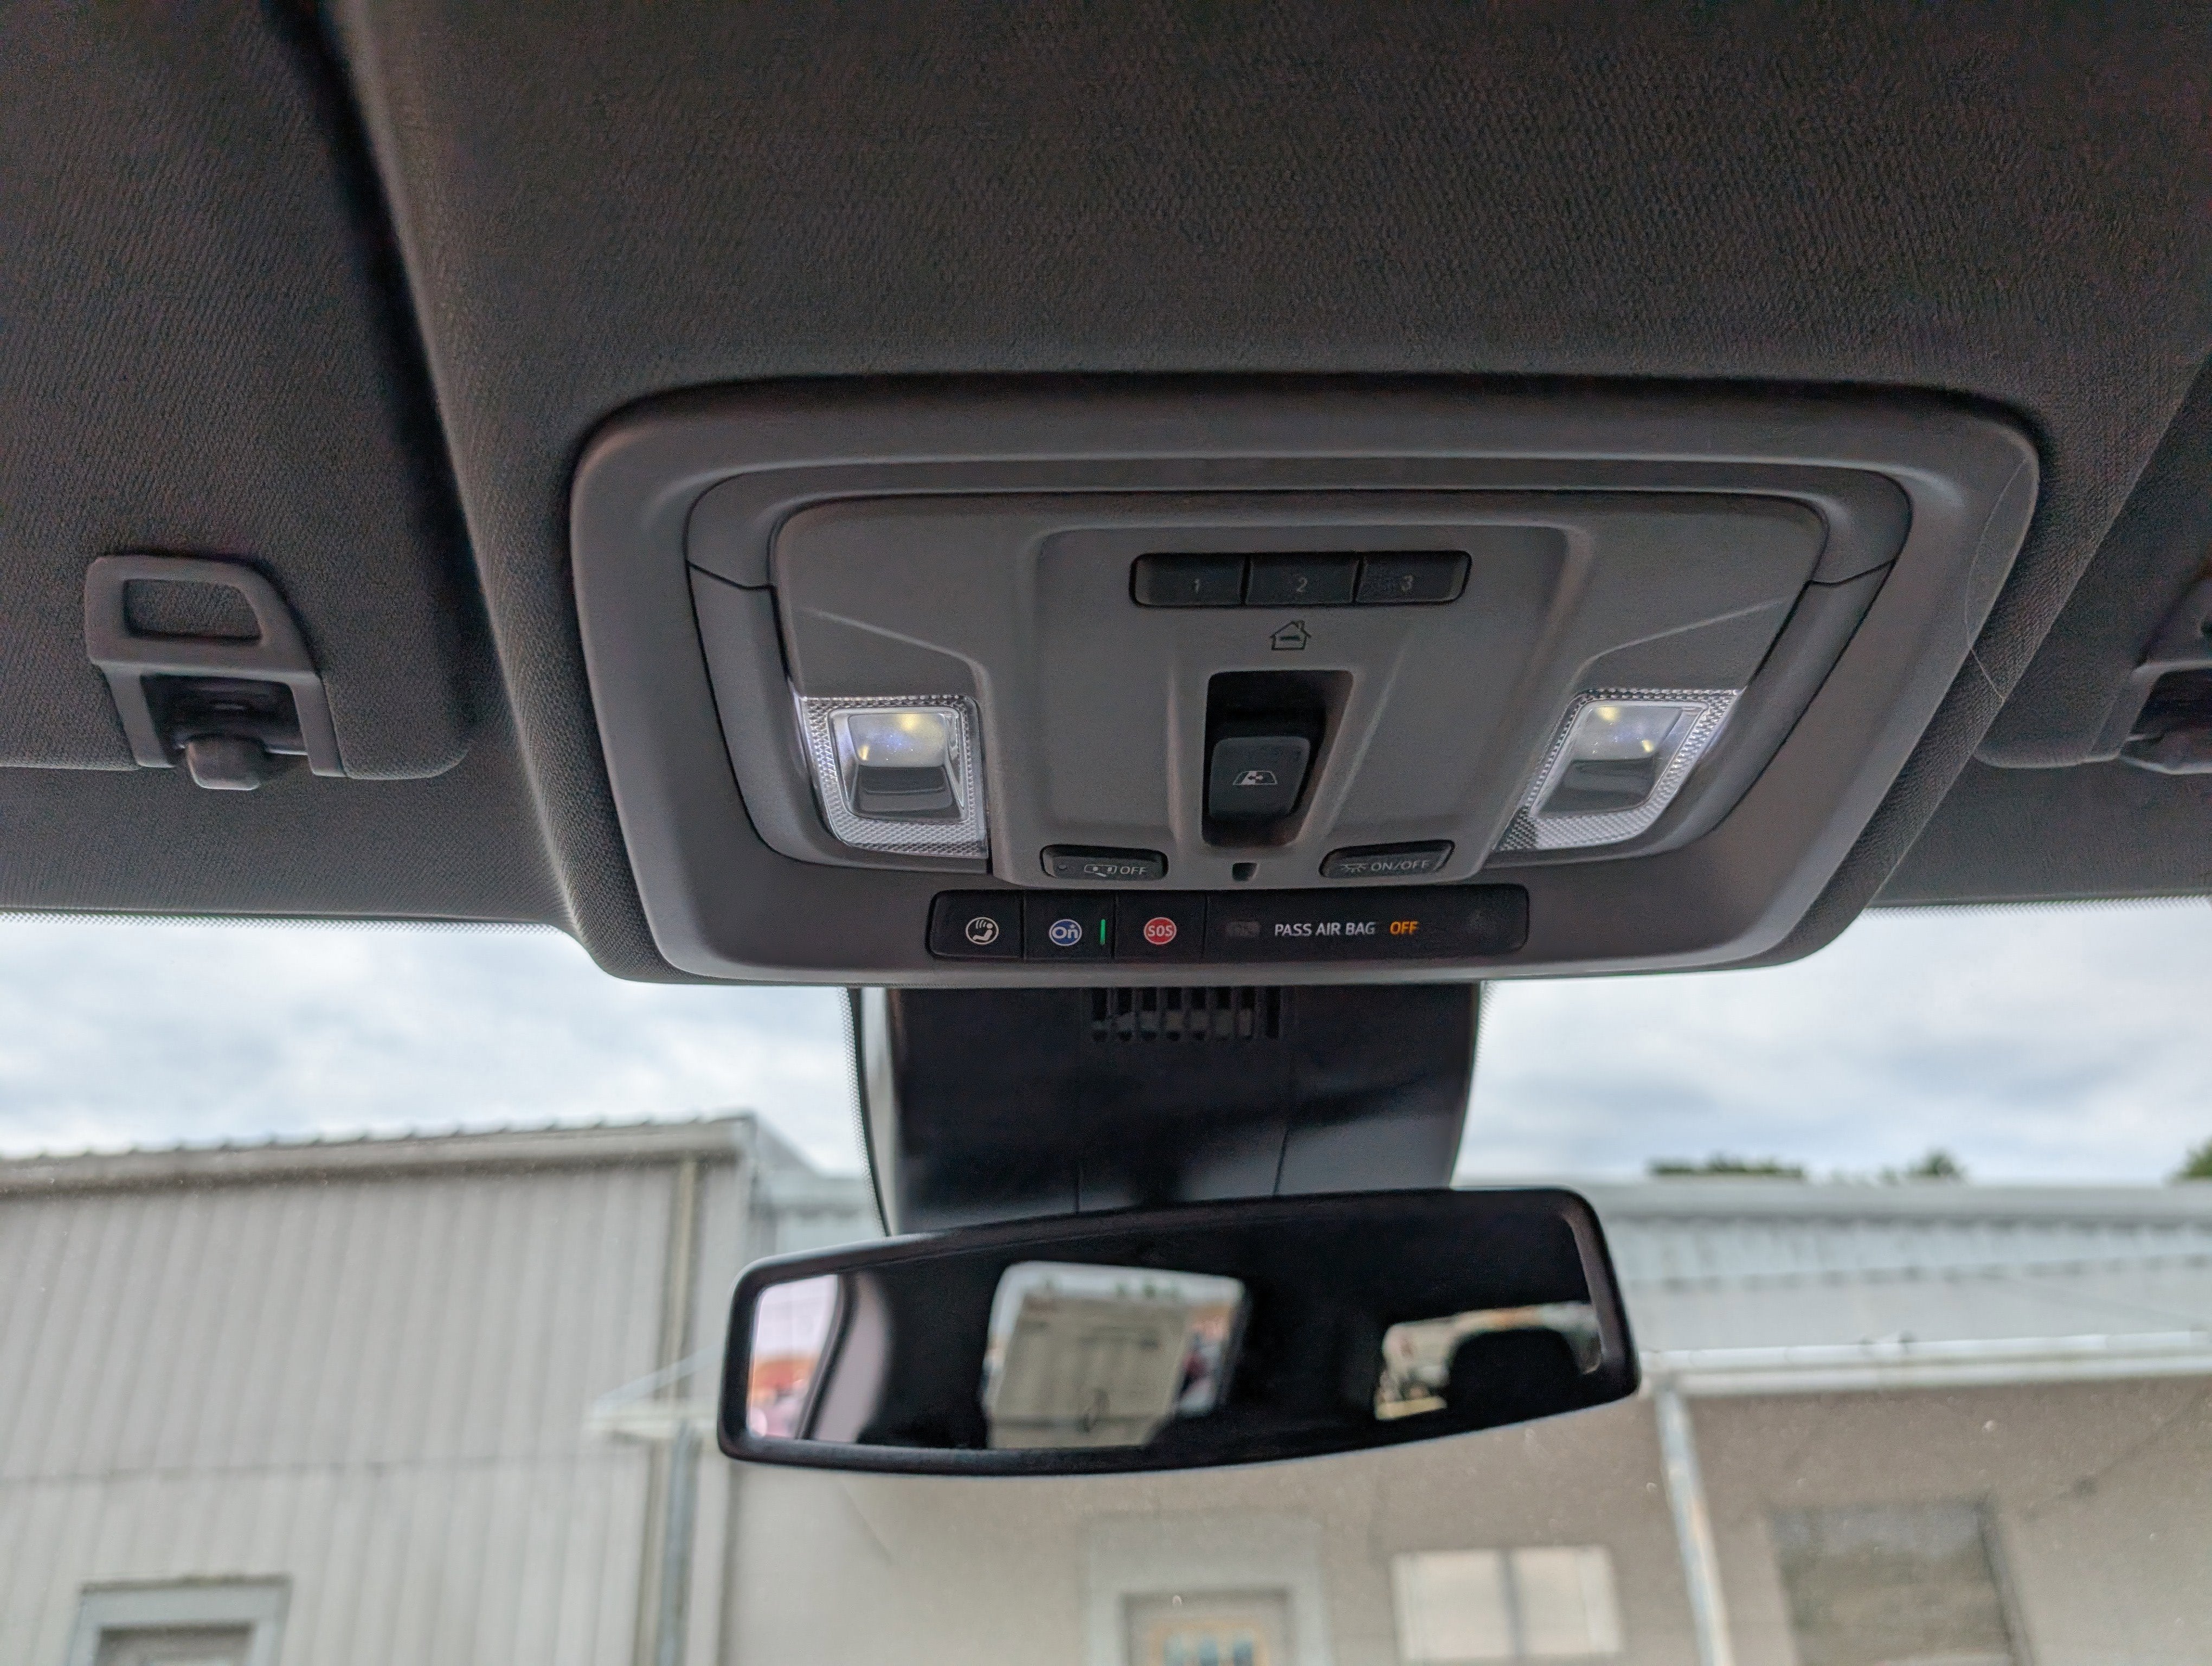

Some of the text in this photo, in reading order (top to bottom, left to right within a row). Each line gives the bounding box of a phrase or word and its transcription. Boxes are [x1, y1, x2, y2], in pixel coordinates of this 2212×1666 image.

[1194, 579, 1200, 593] 1
[1296, 578, 1308, 592] 2
[1401, 575, 1414, 592] 3
[1120, 866, 1146, 875] OFF
[1371, 860, 1430, 872] ON/OFF
[1052, 924, 1079, 939] On
[1148, 924, 1173, 937] SOS
[1275, 921, 1419, 936] PASS AIR BAG OFF
